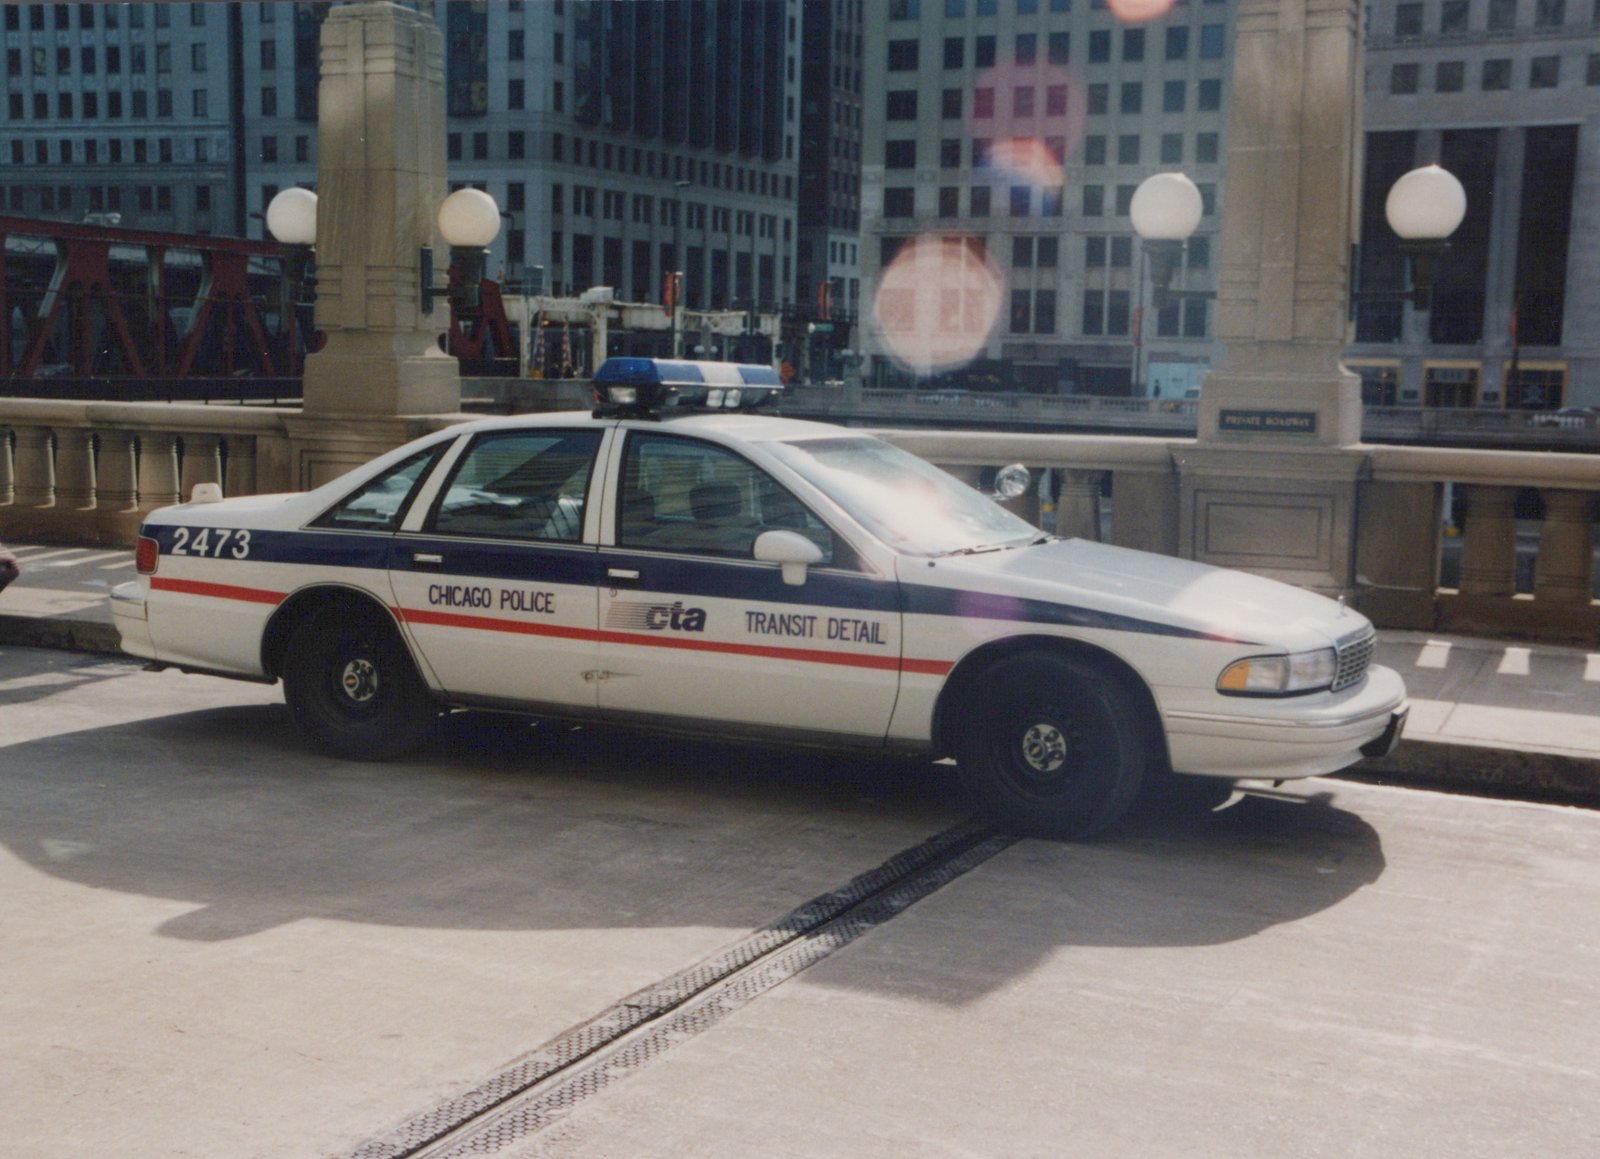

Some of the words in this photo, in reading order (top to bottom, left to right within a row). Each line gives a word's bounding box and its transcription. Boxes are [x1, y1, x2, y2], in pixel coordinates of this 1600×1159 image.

[171, 527, 251, 559] 2473
[429, 584, 492, 608] CHICAGO
[500, 589, 555, 613] POLICE
[645, 601, 707, 632] cta
[745, 611, 817, 637] TRANSIT
[827, 617, 886, 644] DETAIL
